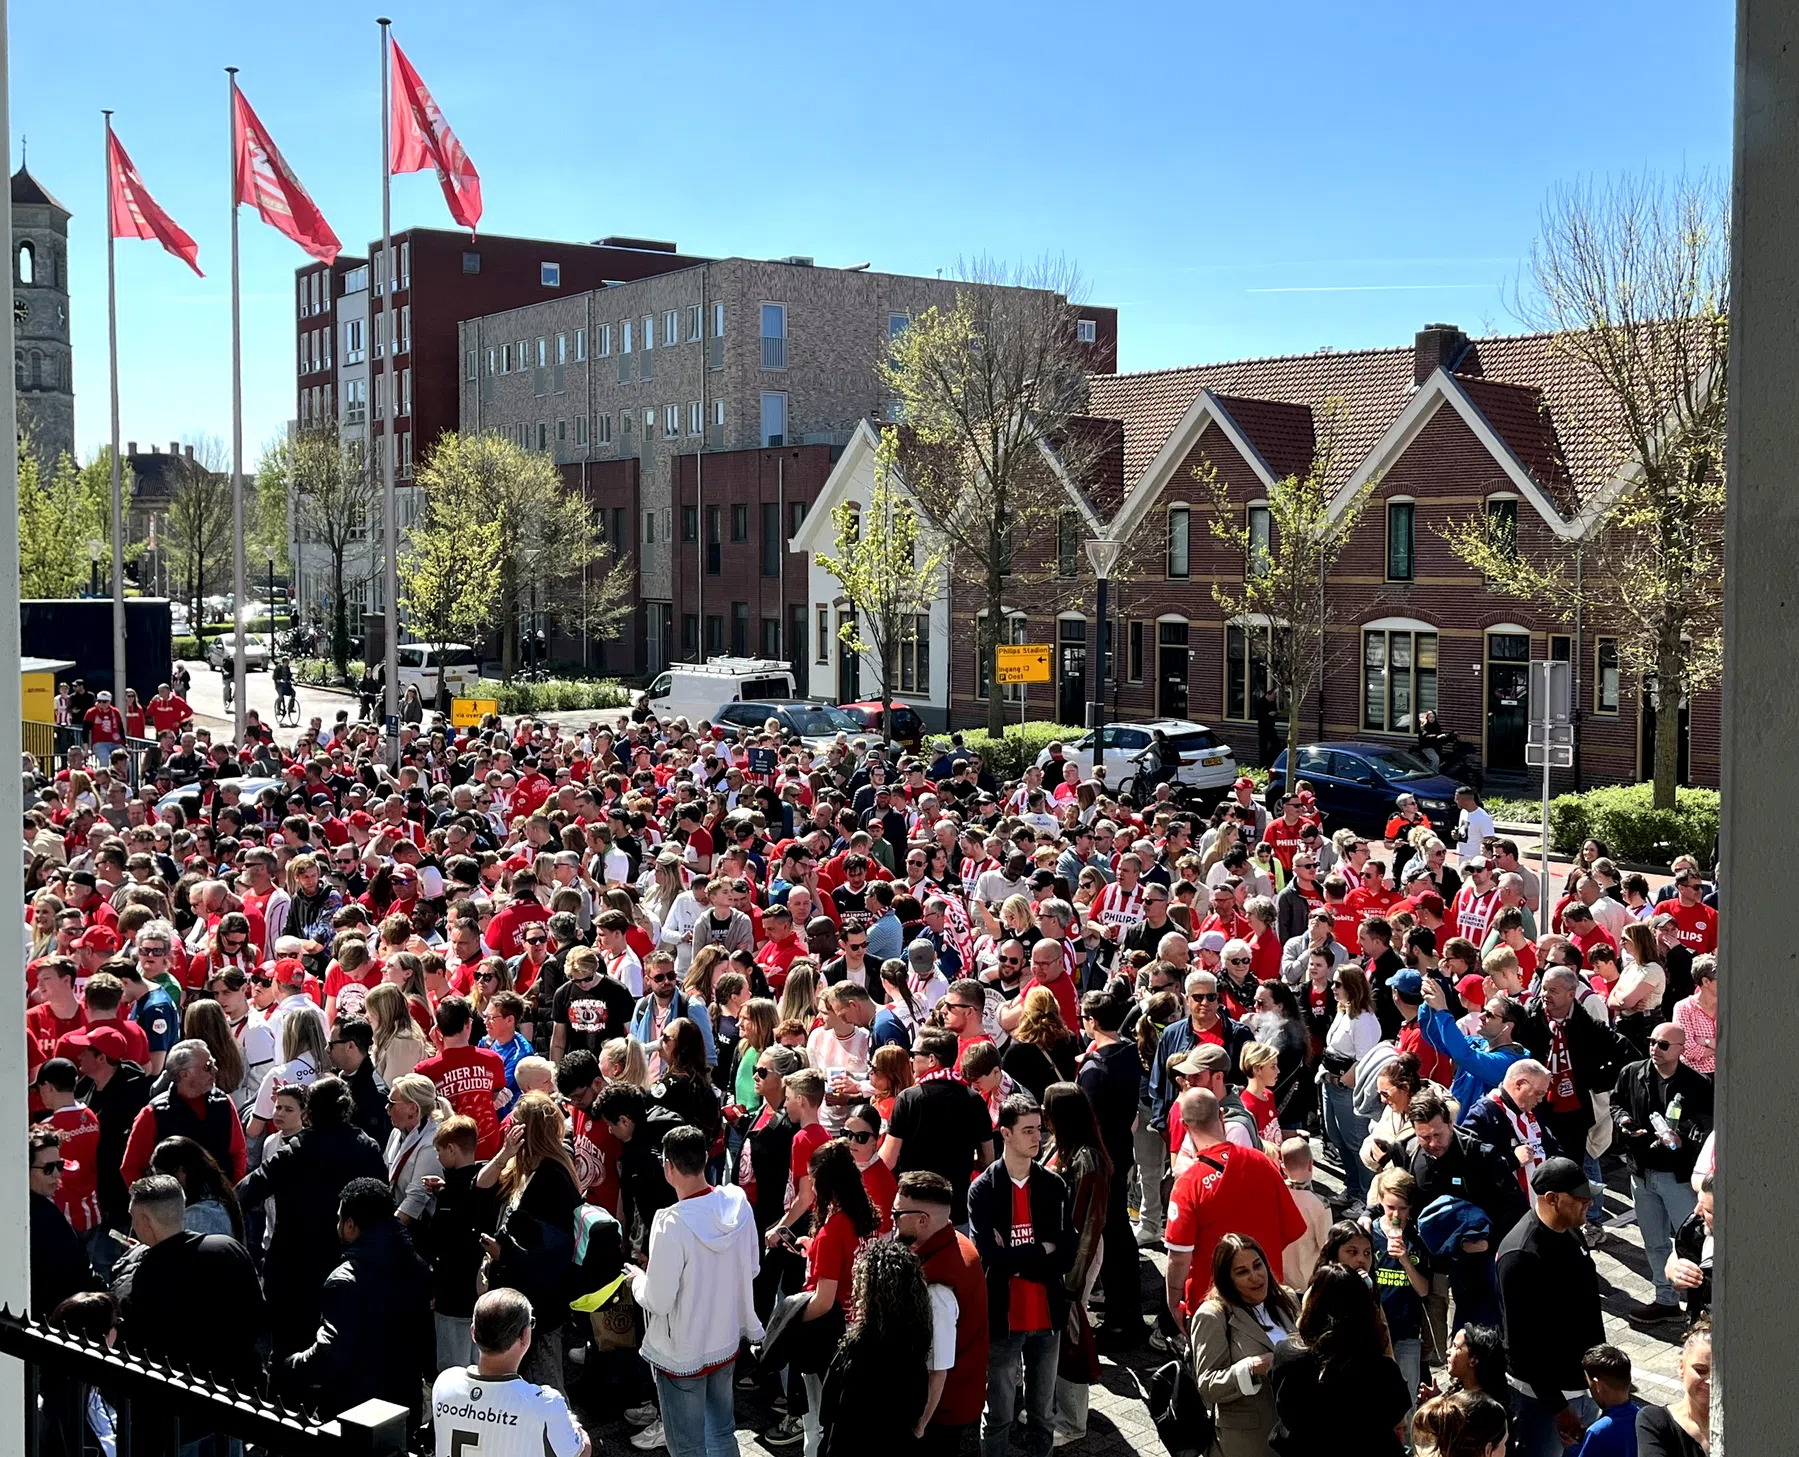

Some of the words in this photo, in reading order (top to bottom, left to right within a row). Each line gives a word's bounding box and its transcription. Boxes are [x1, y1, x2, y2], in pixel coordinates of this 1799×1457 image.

[998, 647, 1020, 656] Philips
[1022, 646, 1048, 655] Stadion
[1104, 912, 1137, 925] PHILIPS
[444, 1067, 471, 1085] HIER
[472, 1065, 486, 1079] IN
[436, 1082, 456, 1099] HET
[456, 1078, 494, 1092] ZUIDEN
[436, 1401, 519, 1427] goodhabitz
